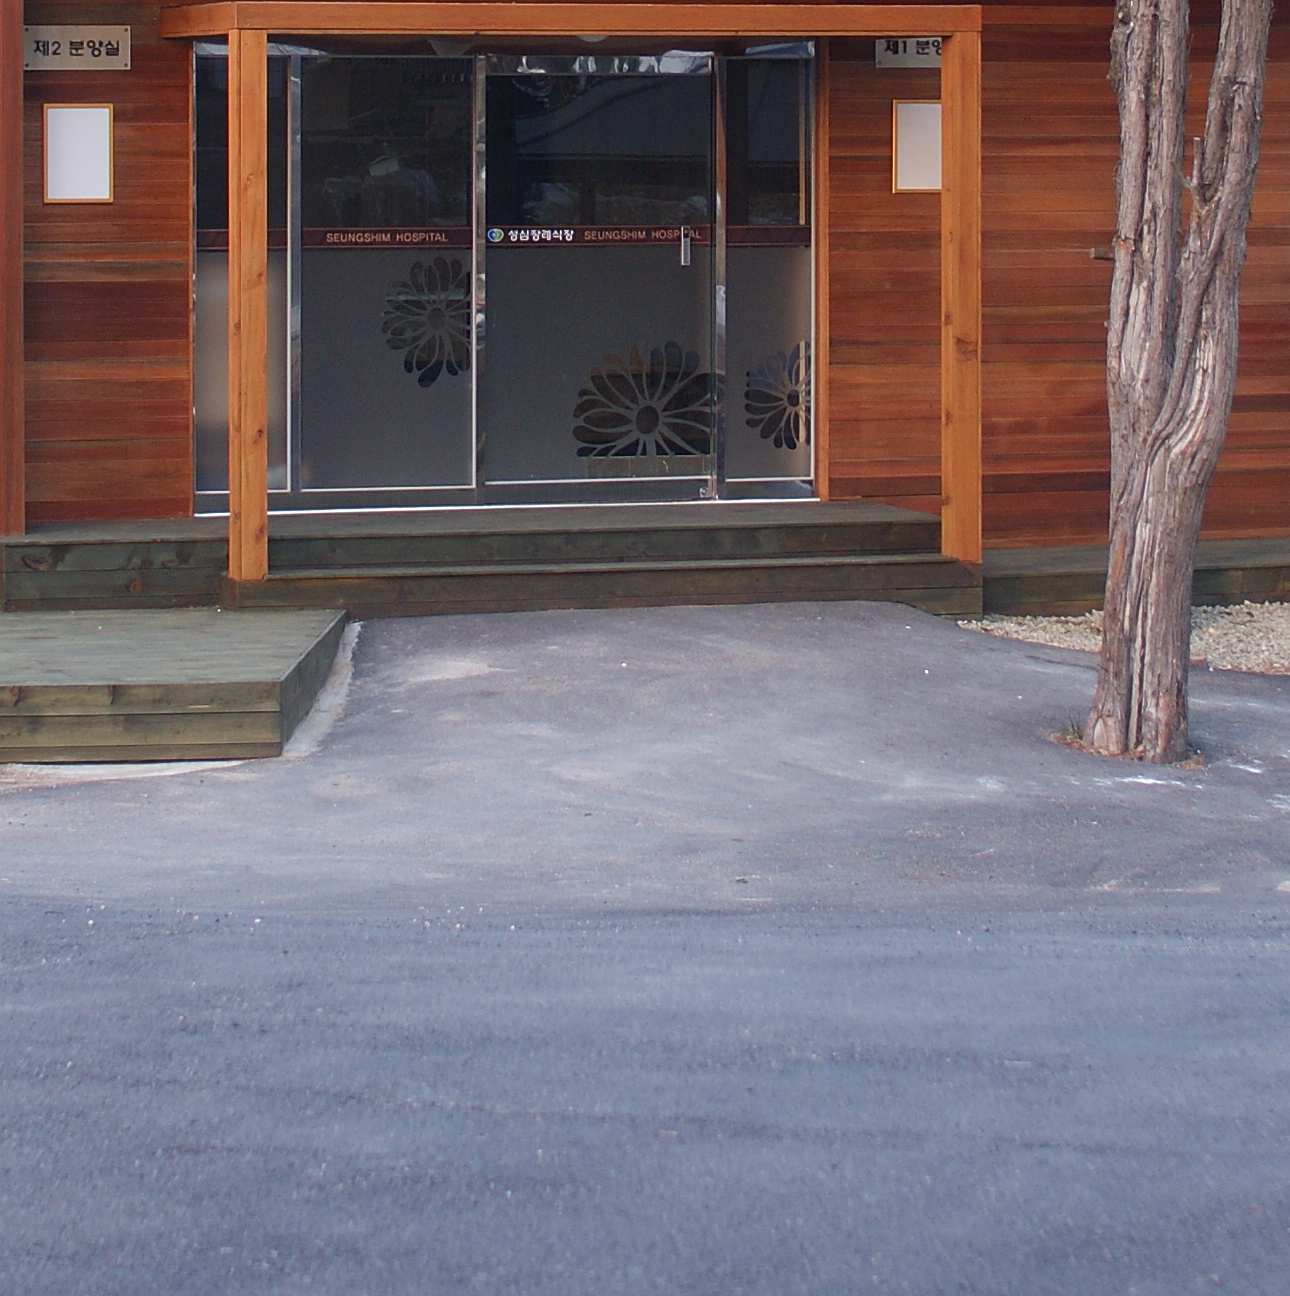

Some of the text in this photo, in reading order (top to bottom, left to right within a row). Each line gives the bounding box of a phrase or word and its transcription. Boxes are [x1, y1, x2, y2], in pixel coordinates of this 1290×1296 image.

[33, 39, 62, 57] 제2
[325, 231, 449, 243] SEUNGSHIM HOSPITAL
[507, 228, 575, 242] 성심장례식장
[583, 229, 646, 241] SEUNGSHIM
